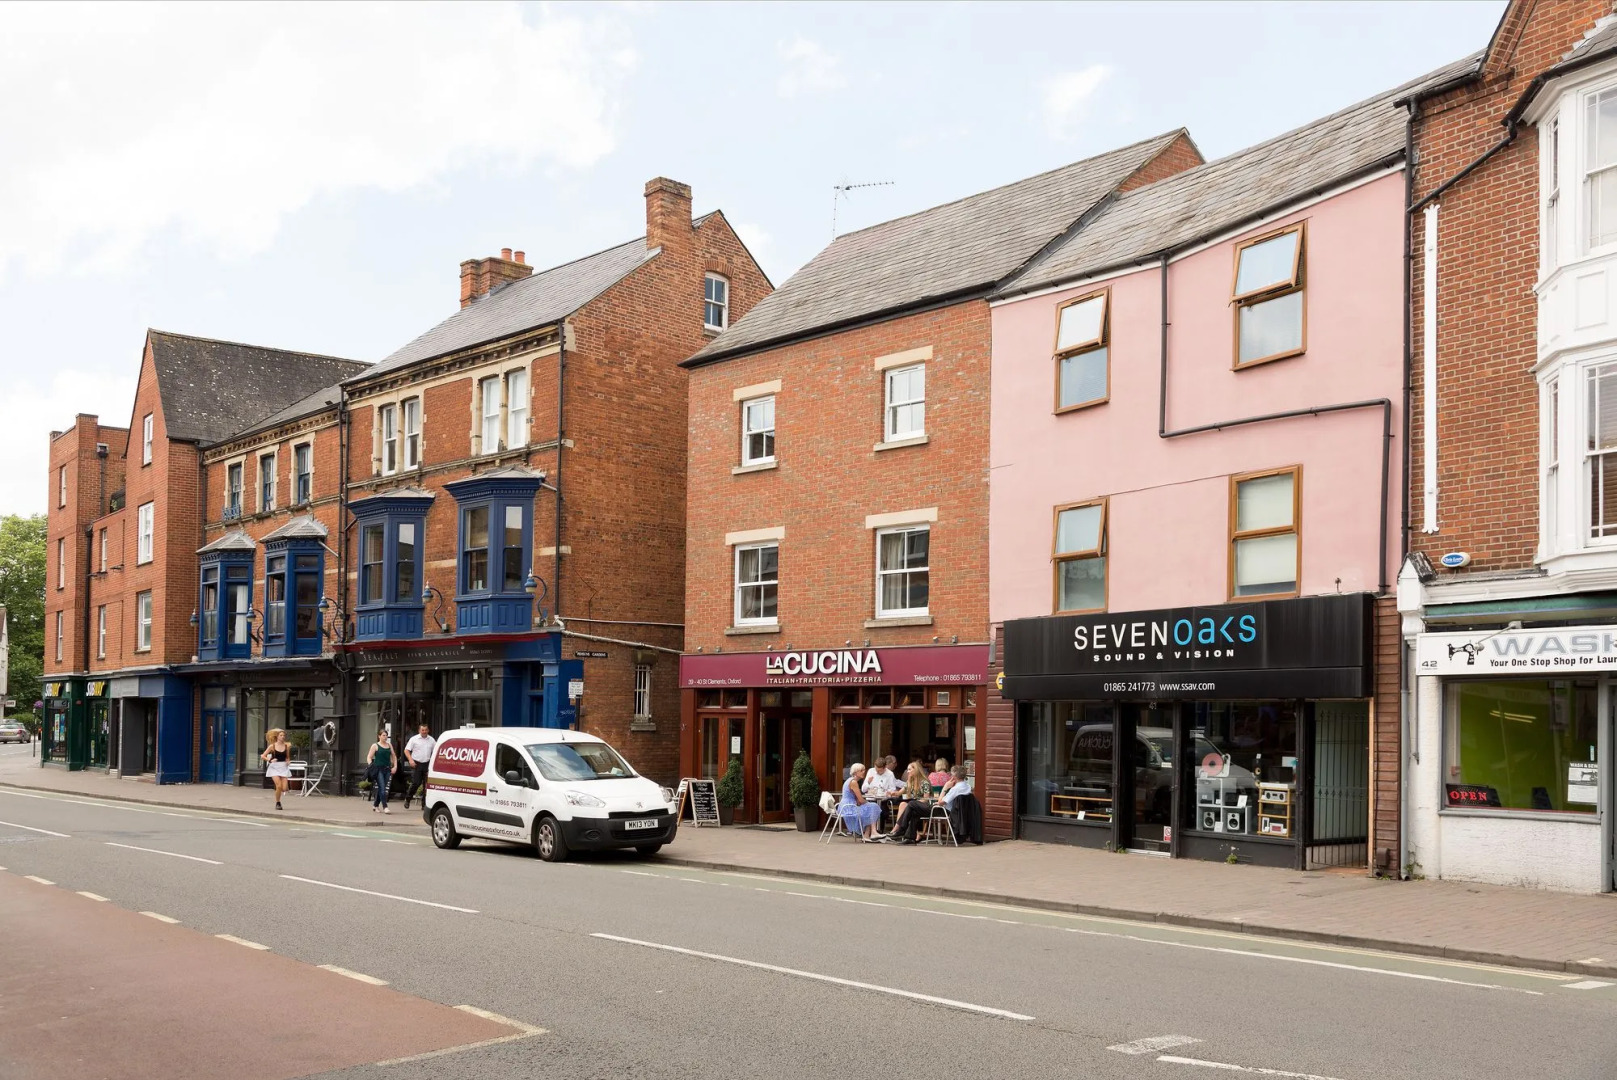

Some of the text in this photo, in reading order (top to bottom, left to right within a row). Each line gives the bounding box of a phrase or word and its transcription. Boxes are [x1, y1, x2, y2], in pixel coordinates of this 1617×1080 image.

[1093, 649, 1234, 662] SOUND & VISION
[1490, 659, 1508, 667] Your
[1530, 658, 1550, 668] Stop
[1553, 656, 1576, 667] Shop
[1579, 655, 1593, 664] for
[783, 650, 882, 675] CUCINA
[914, 674, 940, 682] Telephone
[943, 673, 961, 681] 01865
[961, 673, 982, 681] 793811
[1103, 681, 1216, 692] 01865 241773 www.ssav.com
[445, 747, 484, 762] CUCINA
[1450, 790, 1487, 801] OPEN
[628, 821, 643, 829] MK13
